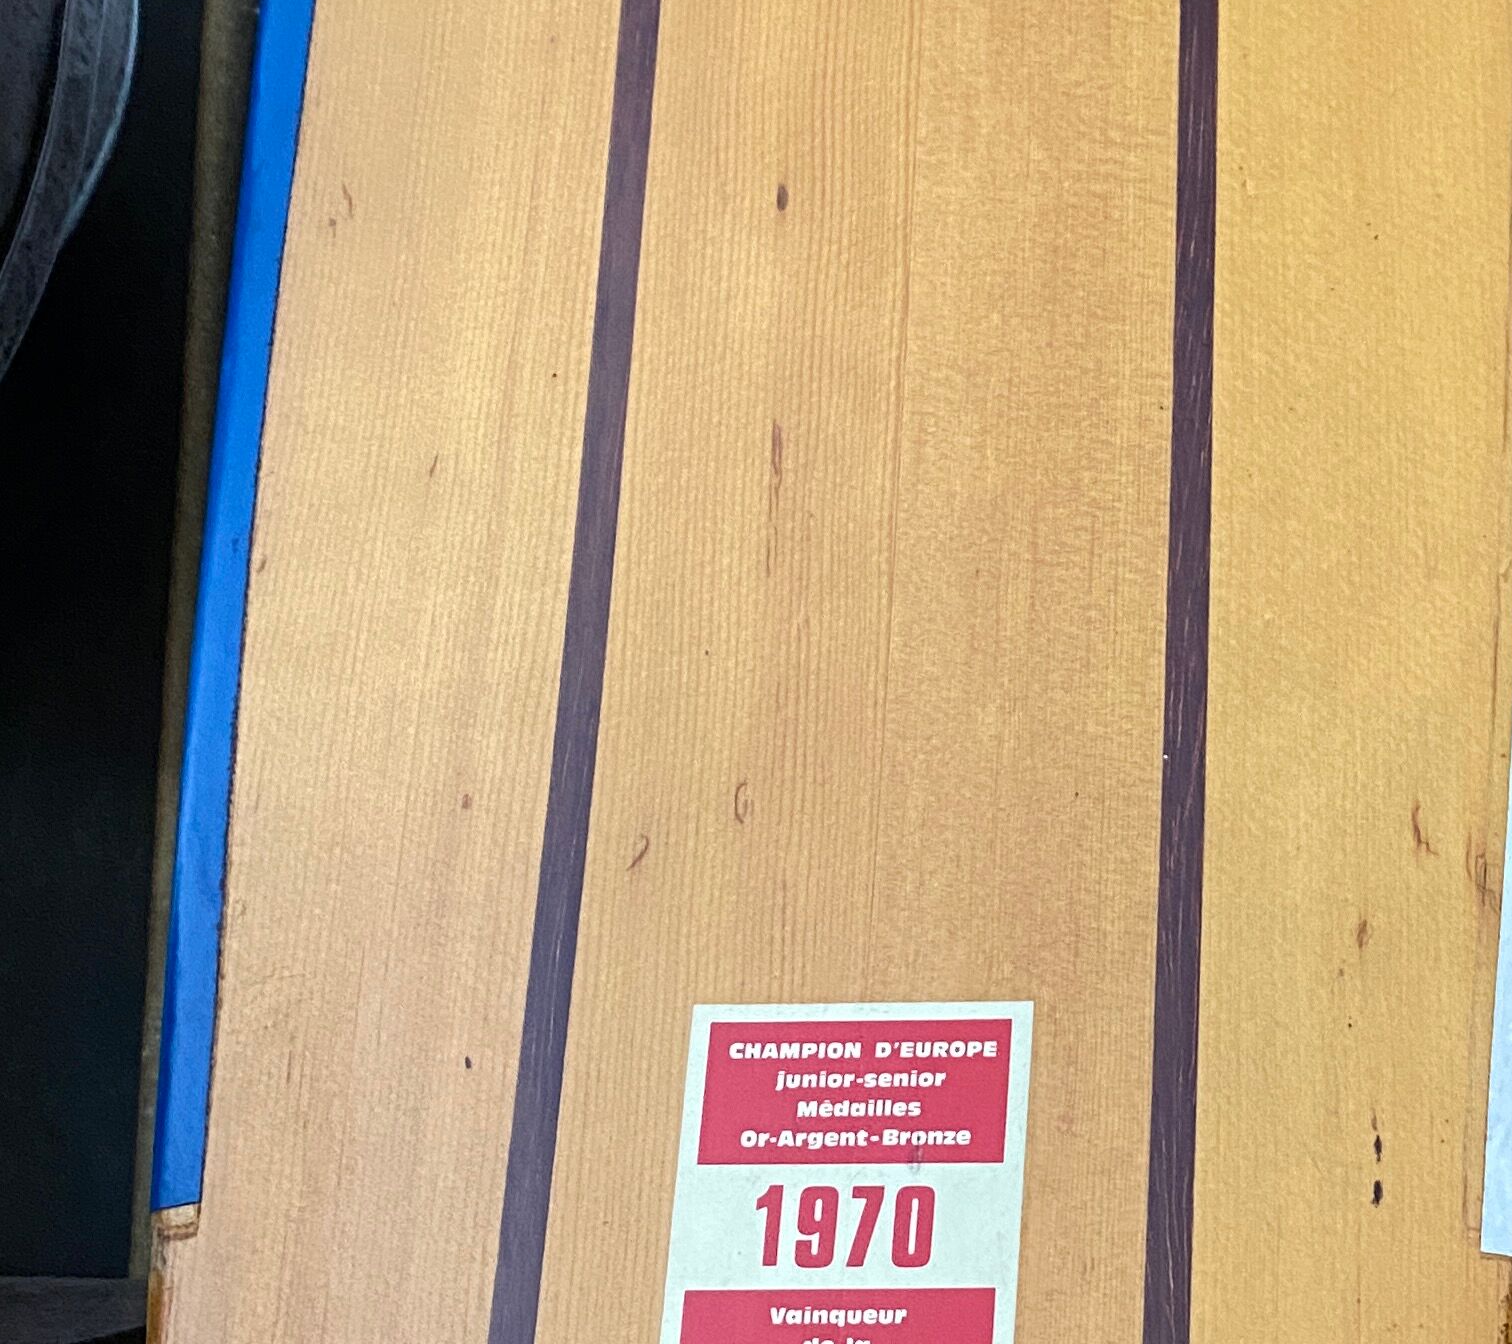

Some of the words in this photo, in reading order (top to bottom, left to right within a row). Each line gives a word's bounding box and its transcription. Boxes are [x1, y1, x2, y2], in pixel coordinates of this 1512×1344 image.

[729, 1041, 861, 1060] CHAMPION
[875, 1040, 997, 1058] D'EUROPE
[775, 1070, 946, 1092] junior-senior
[755, 1184, 936, 1269] 1970
[770, 1306, 908, 1329] Vainqueur
